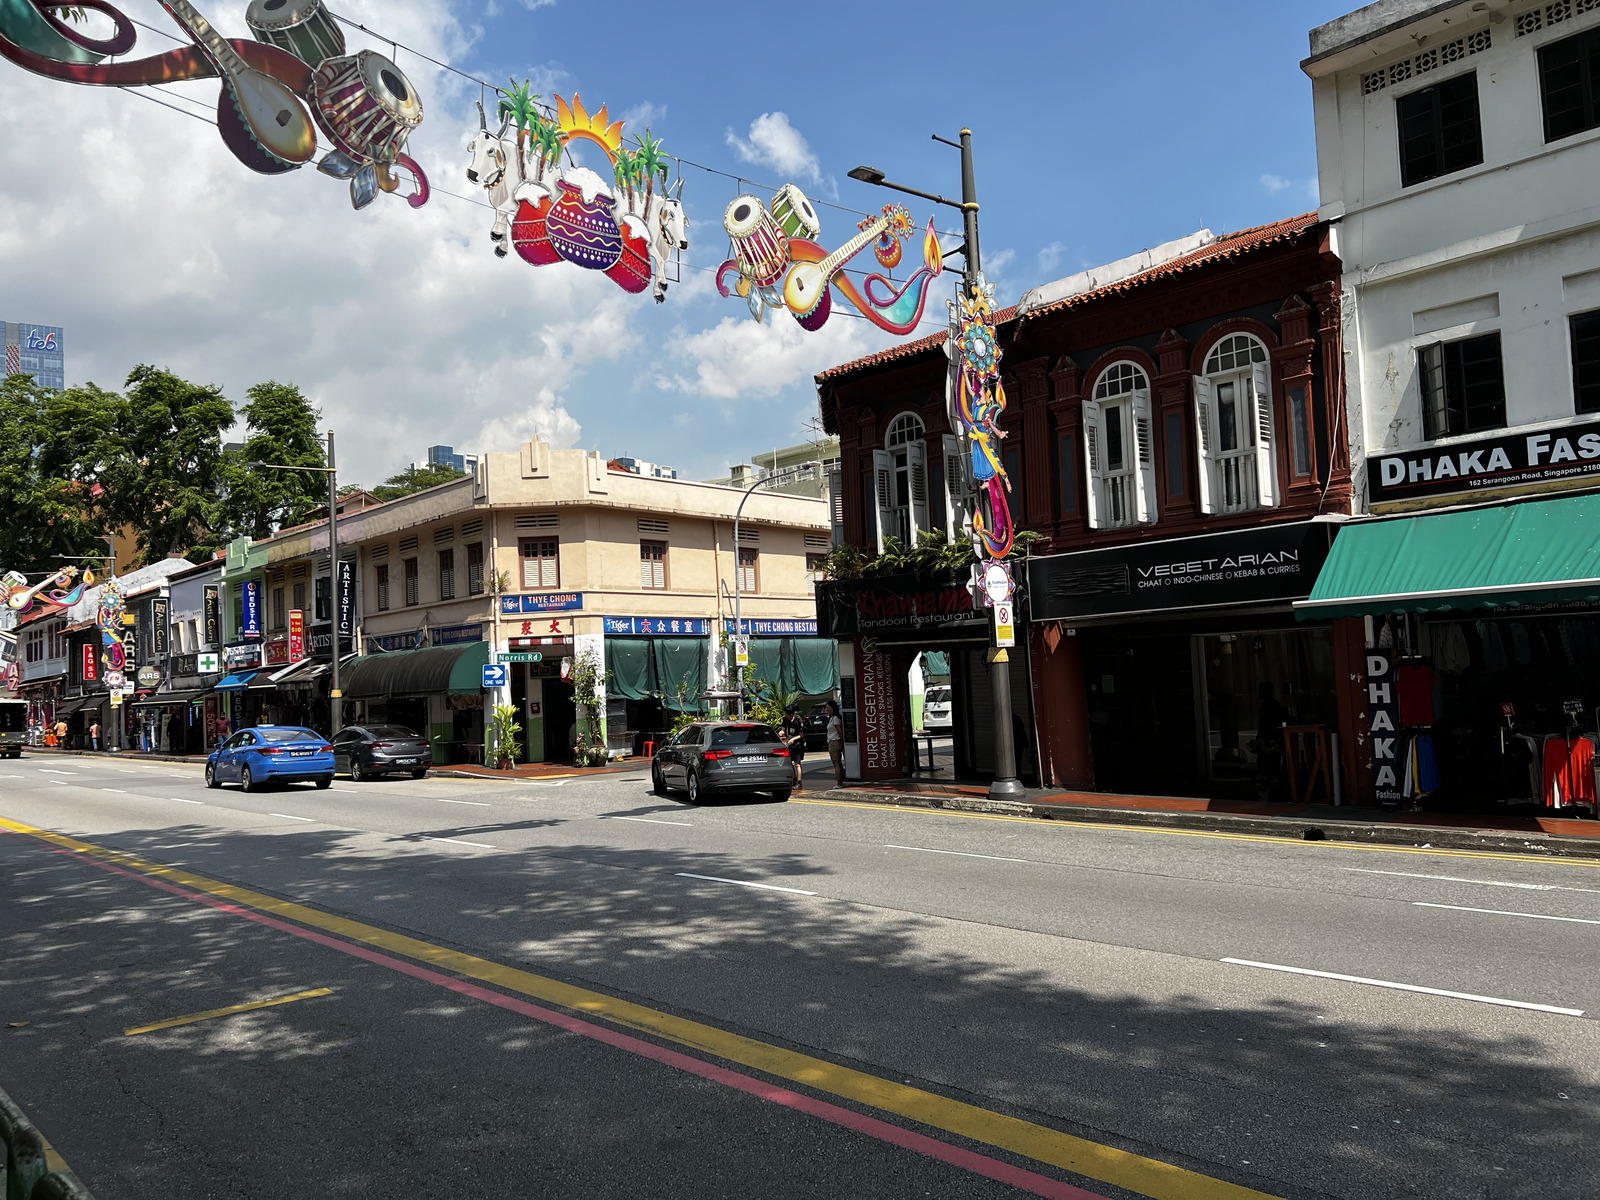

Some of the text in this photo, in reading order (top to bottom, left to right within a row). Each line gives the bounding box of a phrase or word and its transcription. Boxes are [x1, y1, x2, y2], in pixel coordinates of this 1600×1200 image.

[1380, 433, 1600, 487] DHAKA FAS
[1469, 463, 1600, 487] 162 Serangoon Road, Singapore 2180
[1137, 549, 1299, 579] VEGETARIAN
[1137, 578, 1163, 589] CHAAT
[1173, 571, 1224, 585] INDO-CHINESE
[1233, 567, 1258, 579] KEBAB
[1267, 564, 1301, 576] CURRIES
[340, 563, 351, 630] ARTISTIC
[503, 600, 519, 610] Tiger
[527, 593, 577, 604] THYE CHONG
[248, 590, 257, 630] MEDSTAR
[860, 610, 976, 629] Tandoori Restaurant
[610, 619, 630, 633] Tiger
[755, 622, 772, 632] THYE
[772, 622, 794, 632] CHONG
[123, 630, 136, 672] ARS
[499, 653, 525, 661] Norris
[140, 672, 159, 680] ARS
[877, 681, 885, 710] SNACKS
[862, 653, 879, 769] PURE VEGETARIAN
[886, 696, 895, 730] EGG-LESS
[1366, 655, 1397, 787] DHAKA
[878, 712, 887, 740] BIRYANI
[880, 743, 889, 768] CHAAT
[889, 742, 897, 768] CURRIES
[1375, 789, 1401, 800] Fashion
